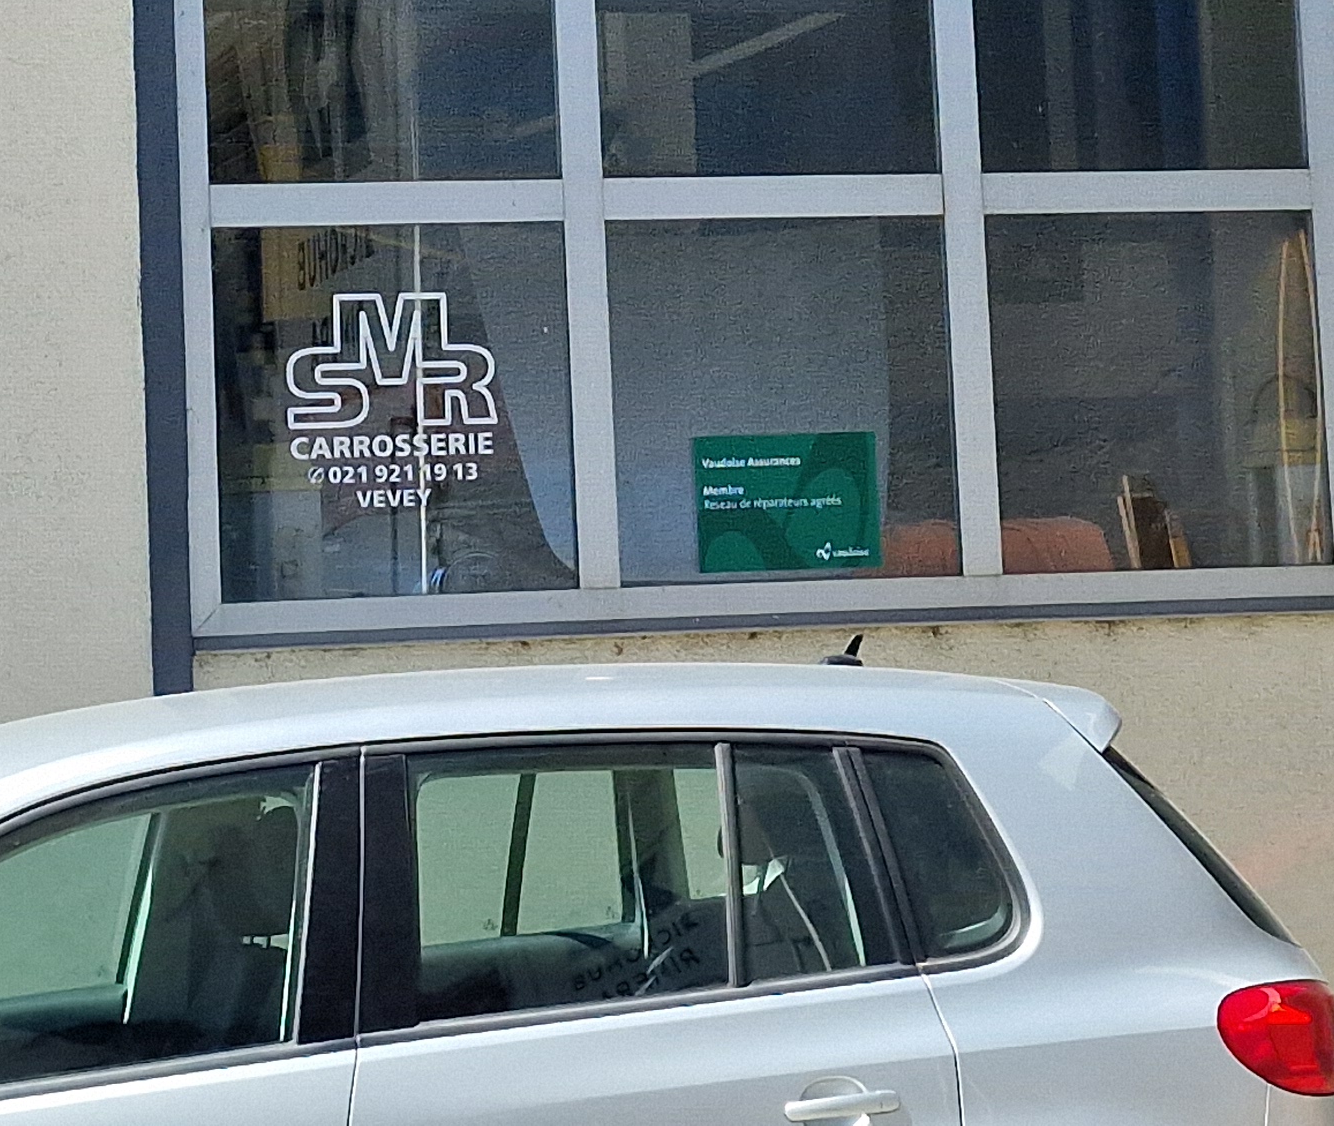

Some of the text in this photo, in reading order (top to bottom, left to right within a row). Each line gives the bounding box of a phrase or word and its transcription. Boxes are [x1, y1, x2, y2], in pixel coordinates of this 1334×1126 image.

[290, 432, 495, 460] CARROSSERIE
[701, 457, 746, 469] Vaudoise
[328, 463, 479, 484] 021 921 19 13
[356, 488, 432, 508] VEVEY
[703, 485, 744, 496] Membre
